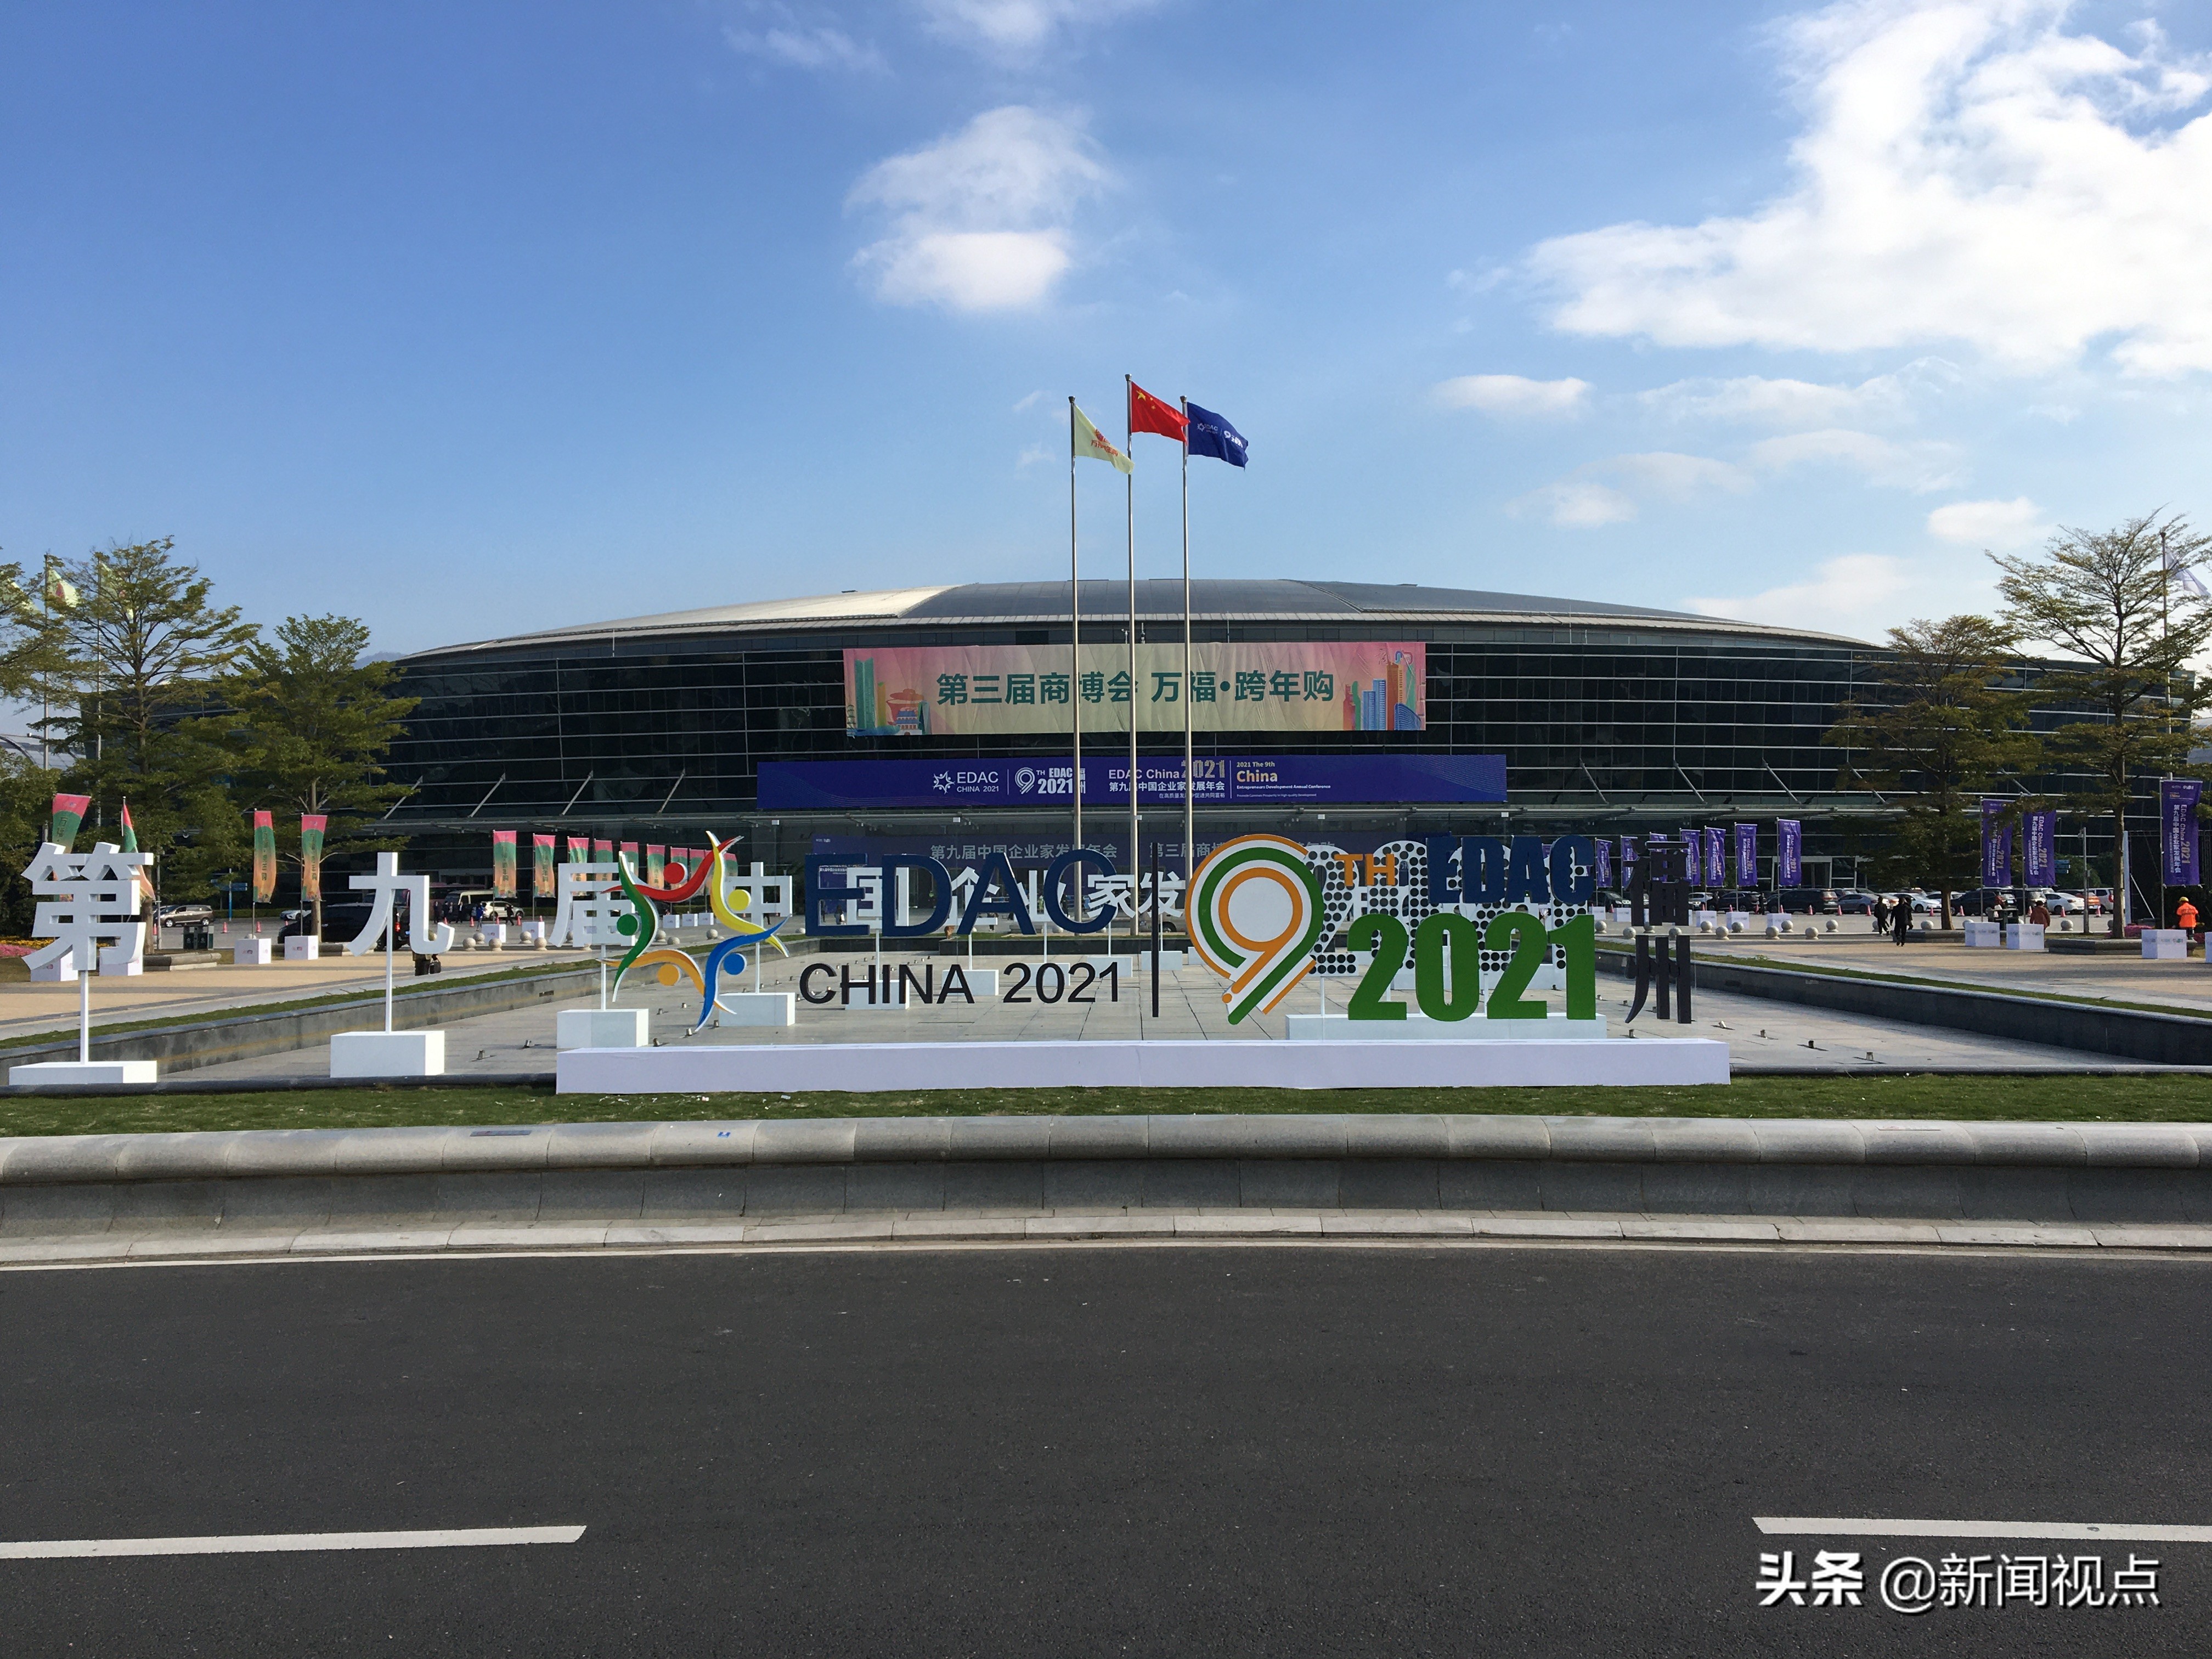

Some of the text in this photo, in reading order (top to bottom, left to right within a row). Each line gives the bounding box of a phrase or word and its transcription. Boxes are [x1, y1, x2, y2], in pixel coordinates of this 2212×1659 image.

[936, 670, 1138, 706] 第三届商博会
[957, 771, 998, 783] EDAC
[1049, 768, 1073, 778] EDAC
[1146, 769, 1179, 779] China
[1237, 770, 1278, 782] China
[1037, 778, 1073, 794] 2021
[1996, 850, 2005, 868] 2021
[2038, 848, 2047, 868] 2021
[2181, 841, 2191, 864] 2021
[1334, 853, 1396, 887] TH
[1426, 835, 1593, 905] EDAC
[805, 848, 1117, 937] EDAC
[1347, 913, 1596, 1022] 2021
[799, 961, 1118, 1005] CHINA 2021
